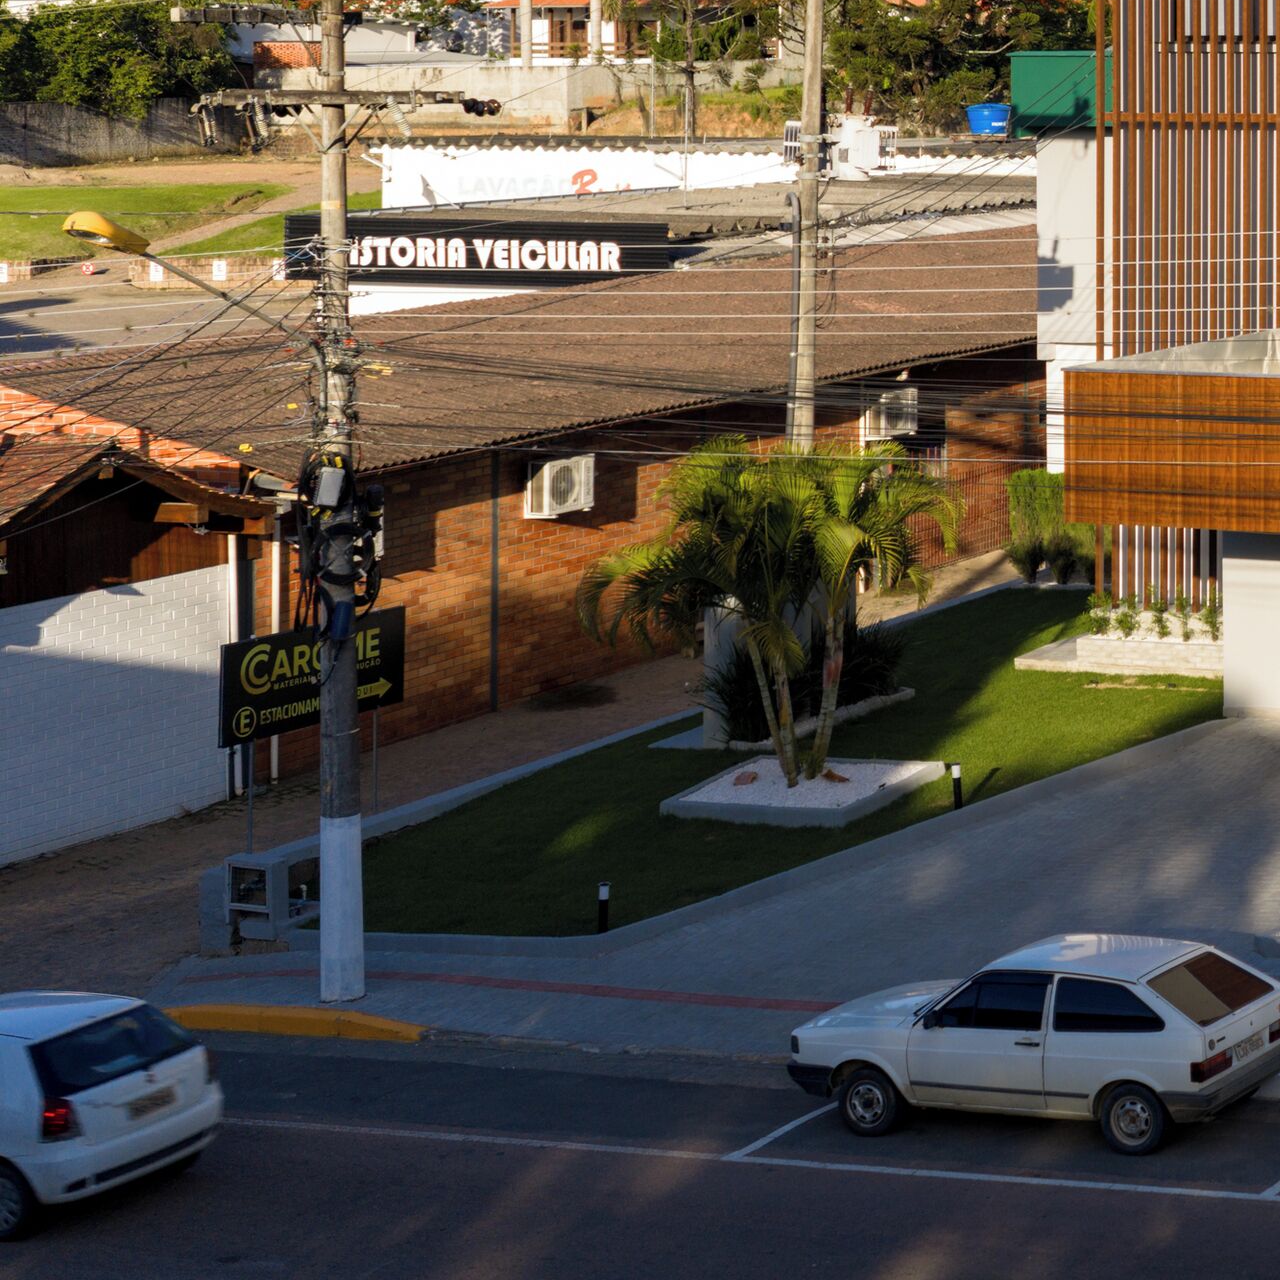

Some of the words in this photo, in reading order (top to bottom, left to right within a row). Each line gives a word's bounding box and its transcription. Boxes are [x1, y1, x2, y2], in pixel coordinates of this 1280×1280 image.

[348, 236, 467, 268] ISTORIA
[472, 238, 621, 272] VEICULAR
[259, 696, 321, 725] ESTACIONAM
